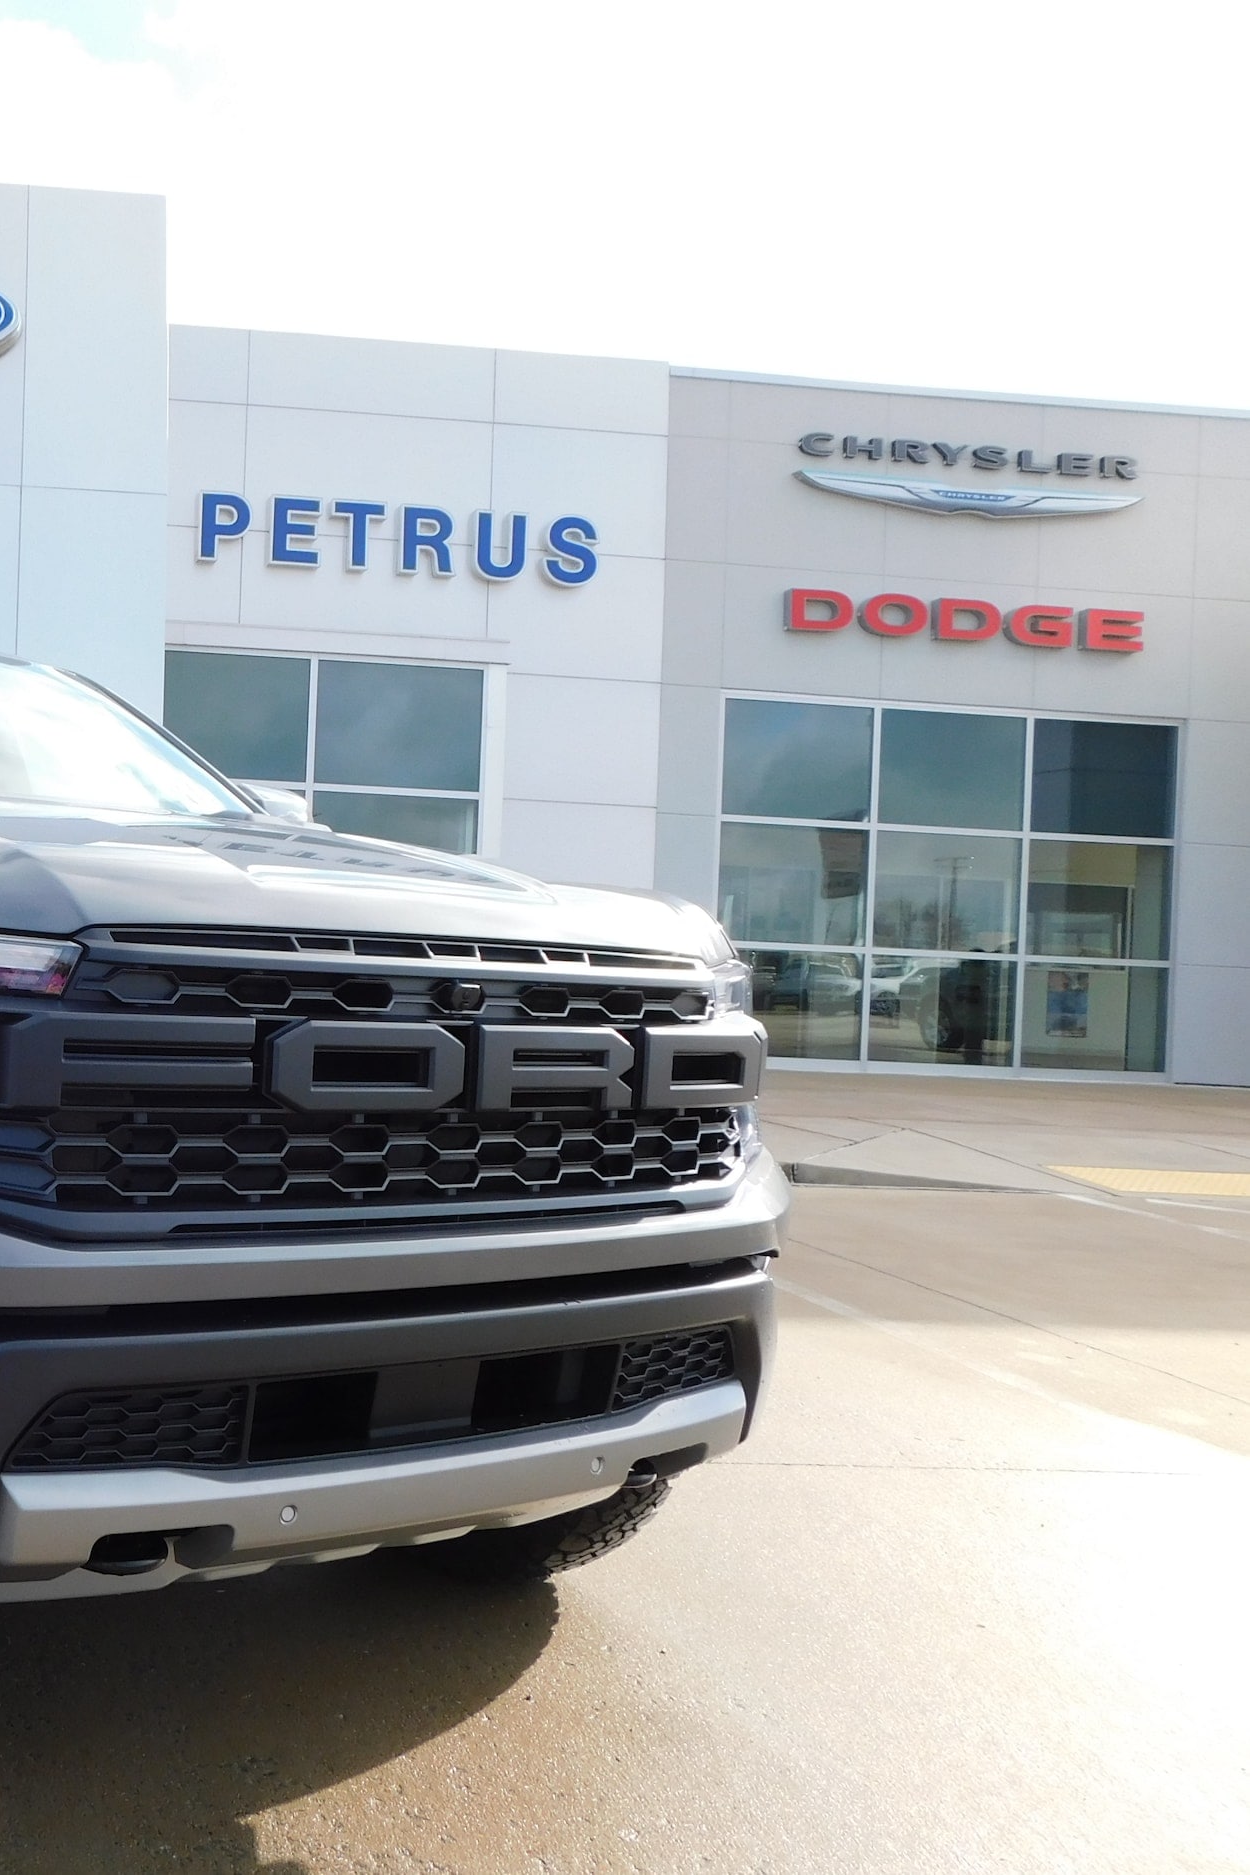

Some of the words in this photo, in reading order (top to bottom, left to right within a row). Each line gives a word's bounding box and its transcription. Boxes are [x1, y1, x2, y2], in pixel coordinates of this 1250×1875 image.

[798, 432, 1137, 480] CHRYSLER
[197, 491, 599, 588] PETRUS
[784, 587, 1145, 652] DODGE
